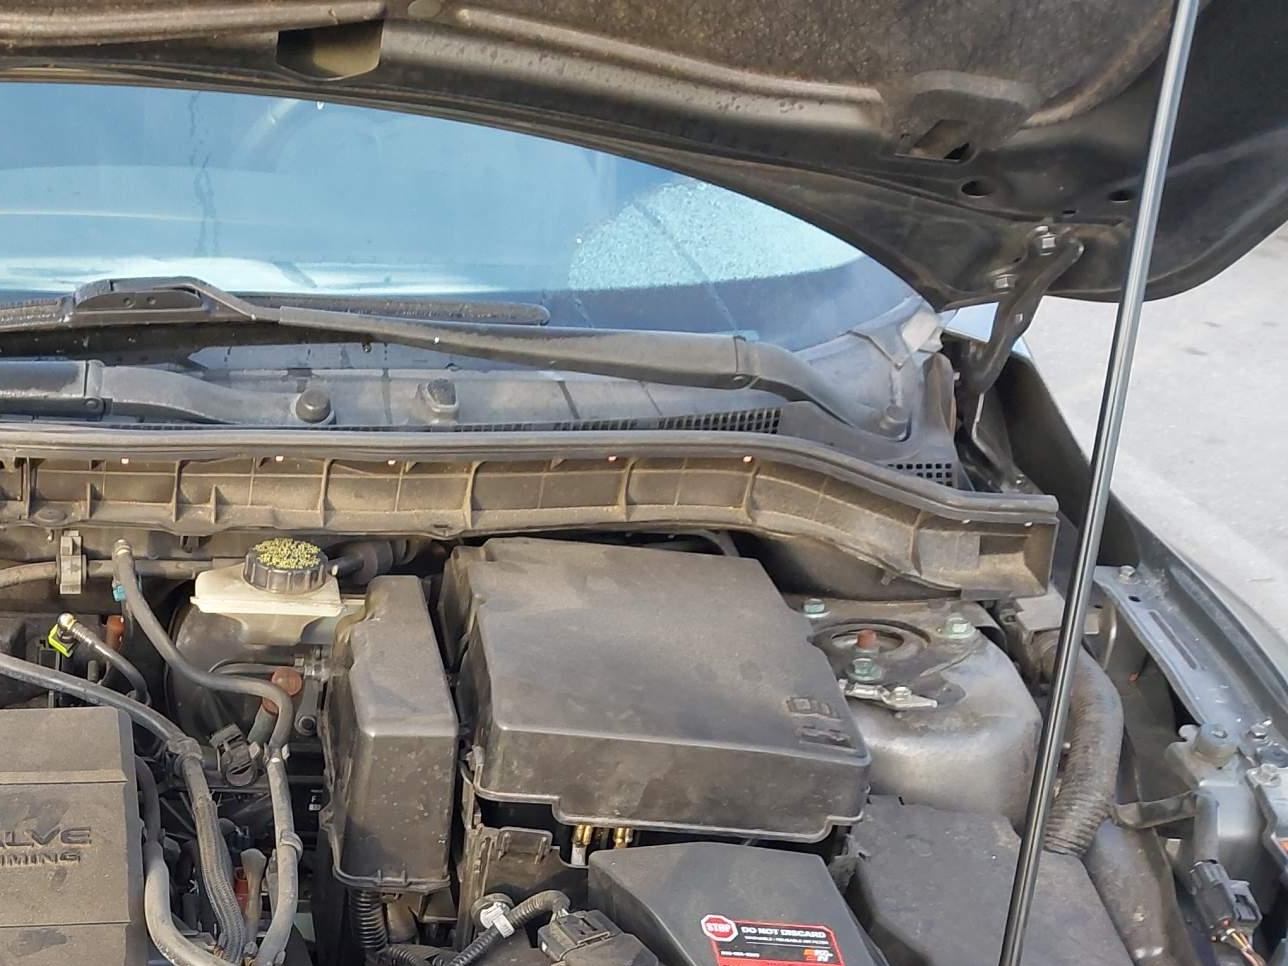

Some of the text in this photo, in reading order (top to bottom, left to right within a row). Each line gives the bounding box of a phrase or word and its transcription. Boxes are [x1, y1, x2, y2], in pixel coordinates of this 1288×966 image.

[706, 922, 731, 933] STOP
[741, 926, 827, 938] DO NOT DISCARD
